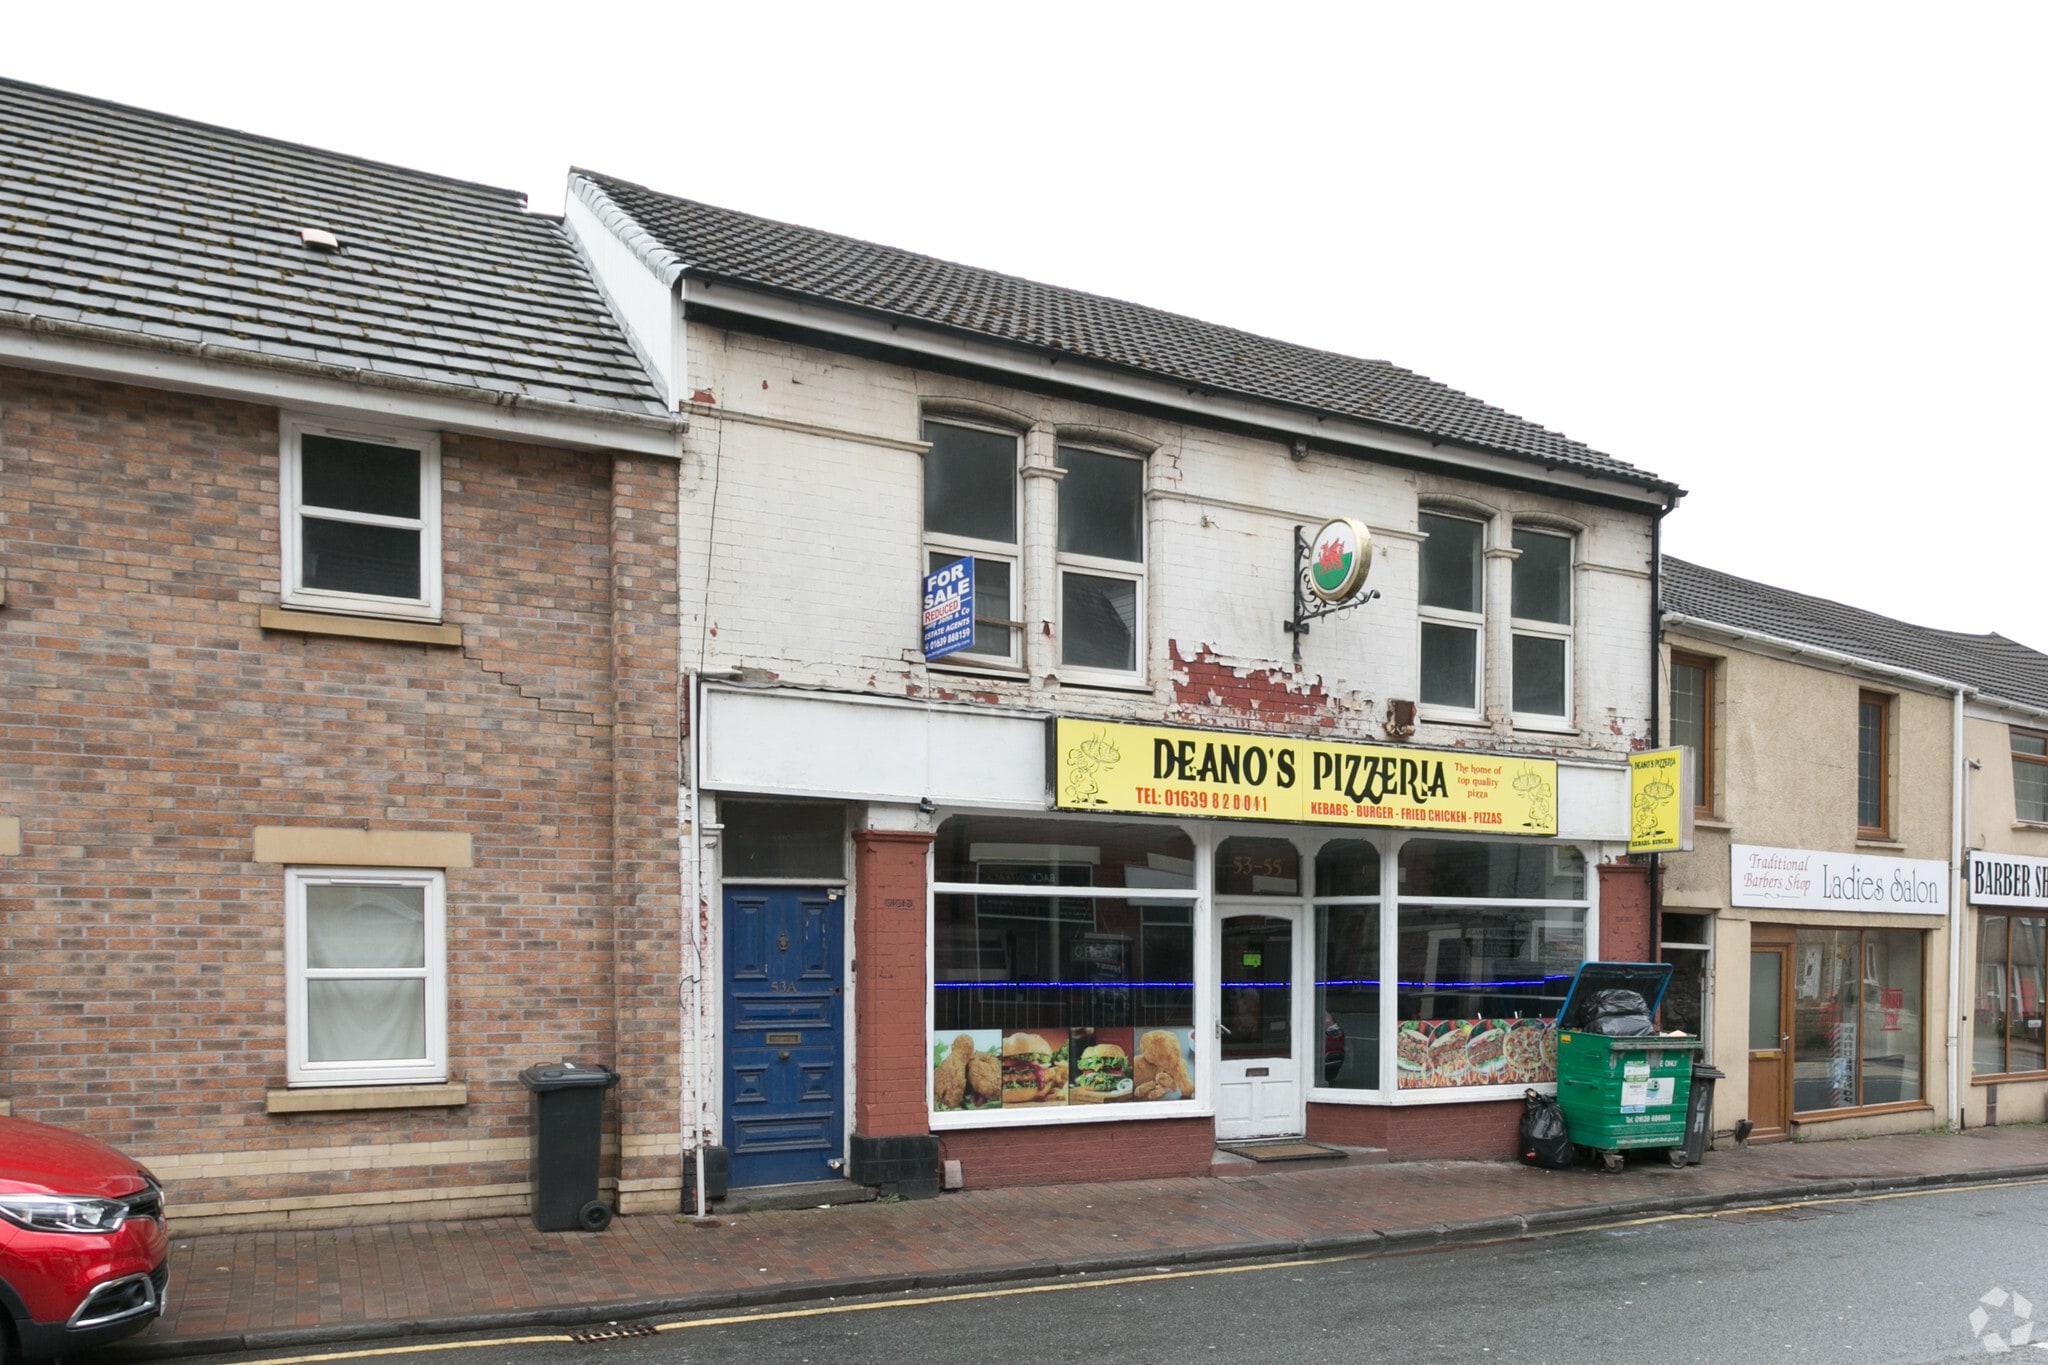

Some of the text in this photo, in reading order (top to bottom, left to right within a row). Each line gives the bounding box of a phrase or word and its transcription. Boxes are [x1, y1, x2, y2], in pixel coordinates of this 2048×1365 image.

[927, 563, 964, 592] FOR
[924, 578, 970, 610] SALE
[925, 600, 959, 623] REDUCED
[924, 626, 944, 640] ESTATE
[945, 617, 970, 633] AGENTS
[1153, 738, 1449, 805] DEANO'S PIZZERIA
[1455, 762, 1502, 775] The home of
[1457, 776, 1499, 789] top quality
[1467, 789, 1488, 799] pizza
[1135, 787, 1162, 805] TEL:
[1164, 789, 1208, 809] 01639
[1311, 802, 1349, 817] KEBABS
[1356, 804, 1394, 819] BURGER
[1401, 808, 1426, 821] FRIED
[1428, 809, 1467, 823] CHICKEN
[1474, 811, 1502, 825] PIZZAS
[1749, 853, 1811, 872] Traditional
[1744, 872, 1811, 897] Barbers Shop
[1823, 864, 1939, 904] Ladies Salon
[1974, 860, 2031, 897] BARBER
[772, 981, 797, 993] 53A
